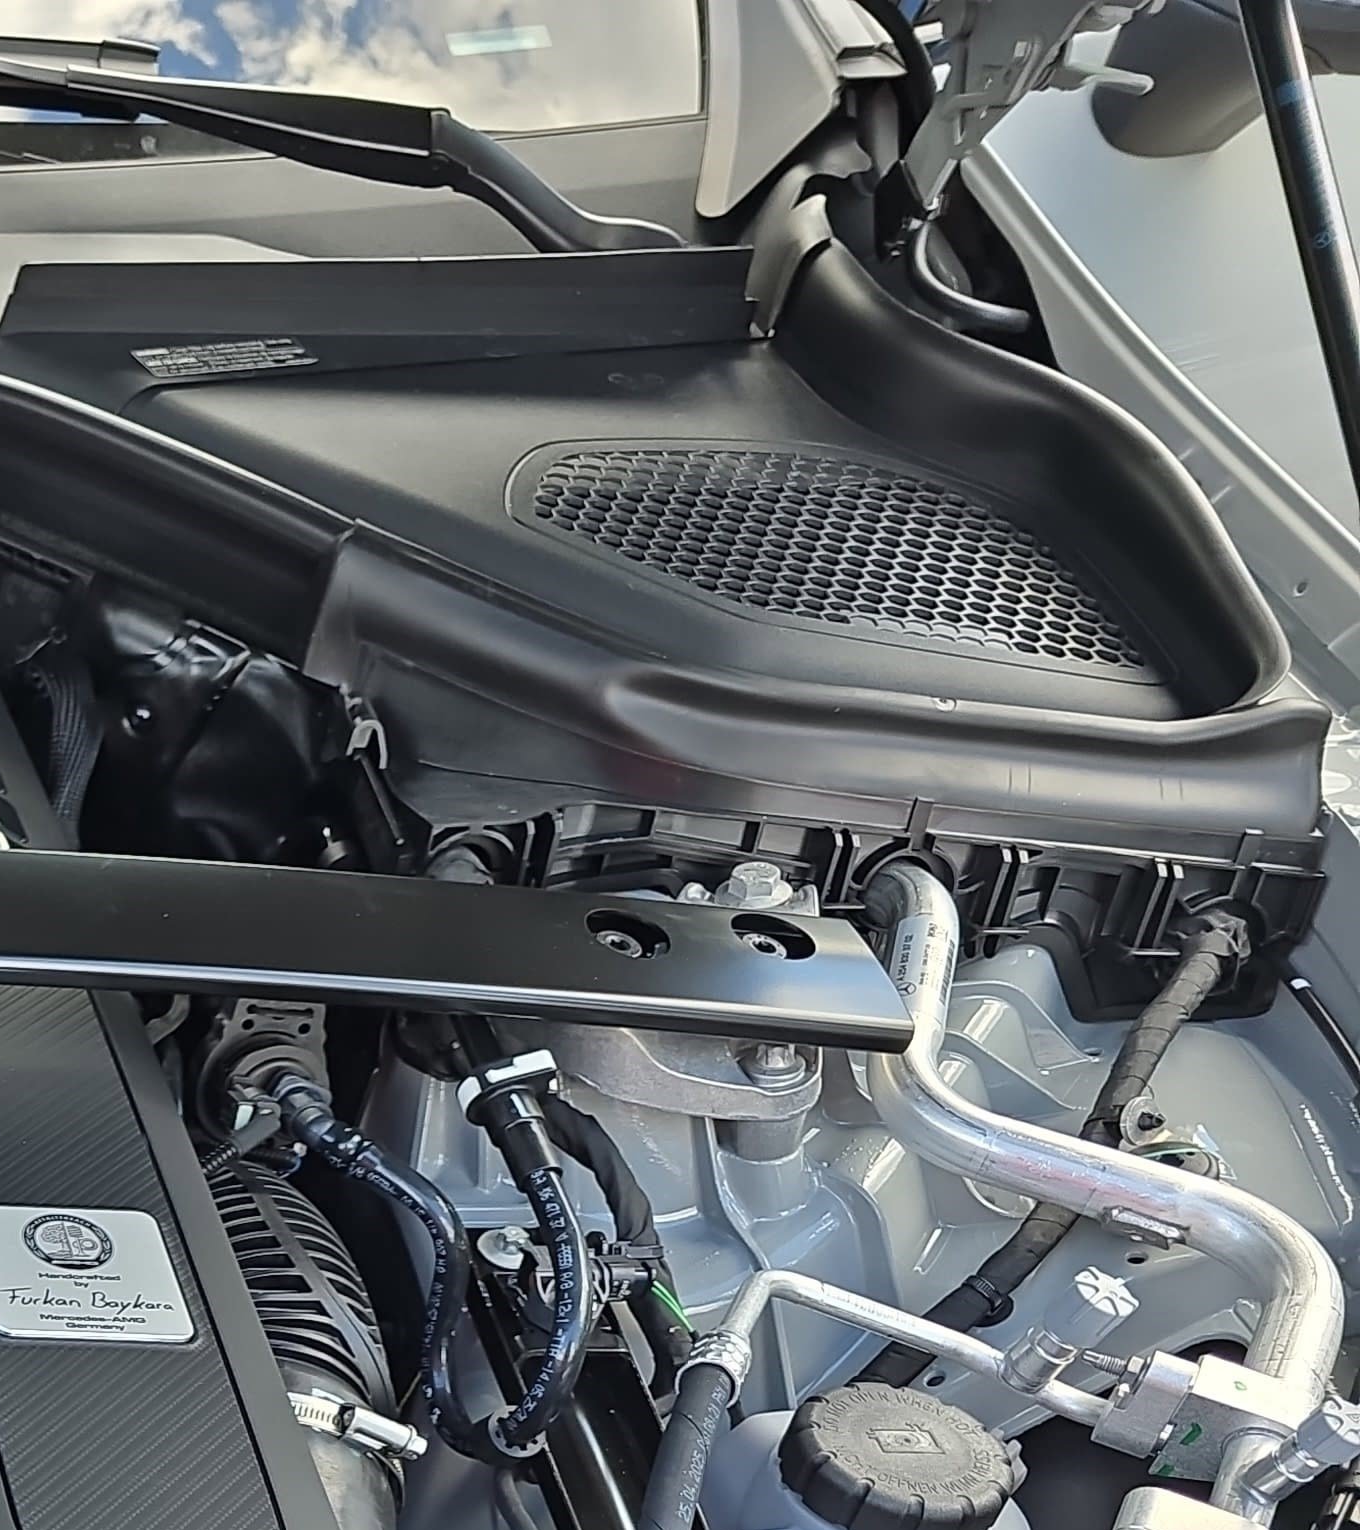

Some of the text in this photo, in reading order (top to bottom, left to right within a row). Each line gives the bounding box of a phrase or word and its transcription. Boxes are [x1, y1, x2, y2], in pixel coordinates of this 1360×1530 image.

[38, 1272, 121, 1281] Handcrafted
[74, 1280, 89, 1288] by
[0, 1287, 174, 1315] Furkan Baykara
[39, 1314, 146, 1324] Mercedes-AMG
[65, 1322, 125, 1331] Germany
